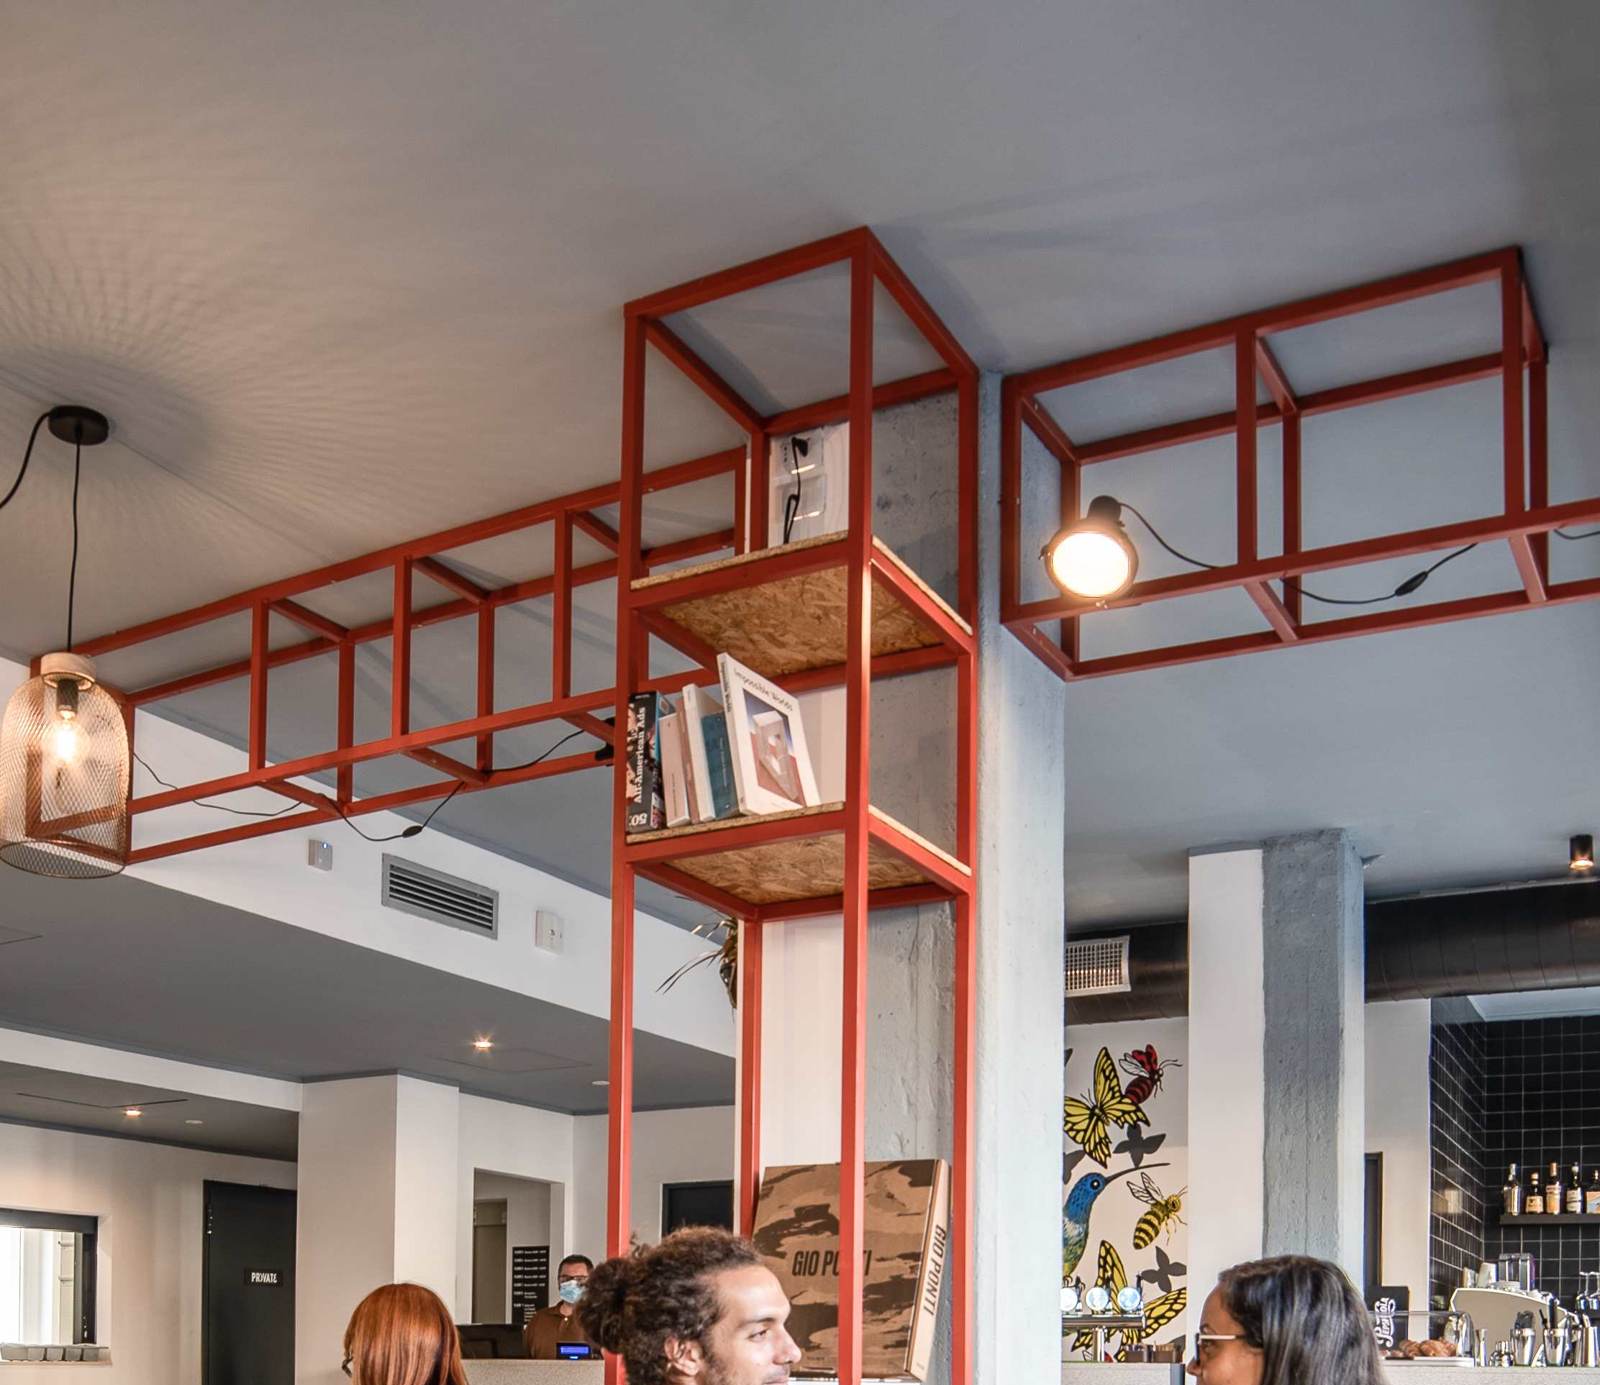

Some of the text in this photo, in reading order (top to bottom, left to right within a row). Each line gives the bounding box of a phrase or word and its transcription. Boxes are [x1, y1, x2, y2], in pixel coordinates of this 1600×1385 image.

[637, 707, 646, 728] Ads
[792, 1249, 820, 1277] GIO
[923, 1224, 947, 1316] GIO PONTI
